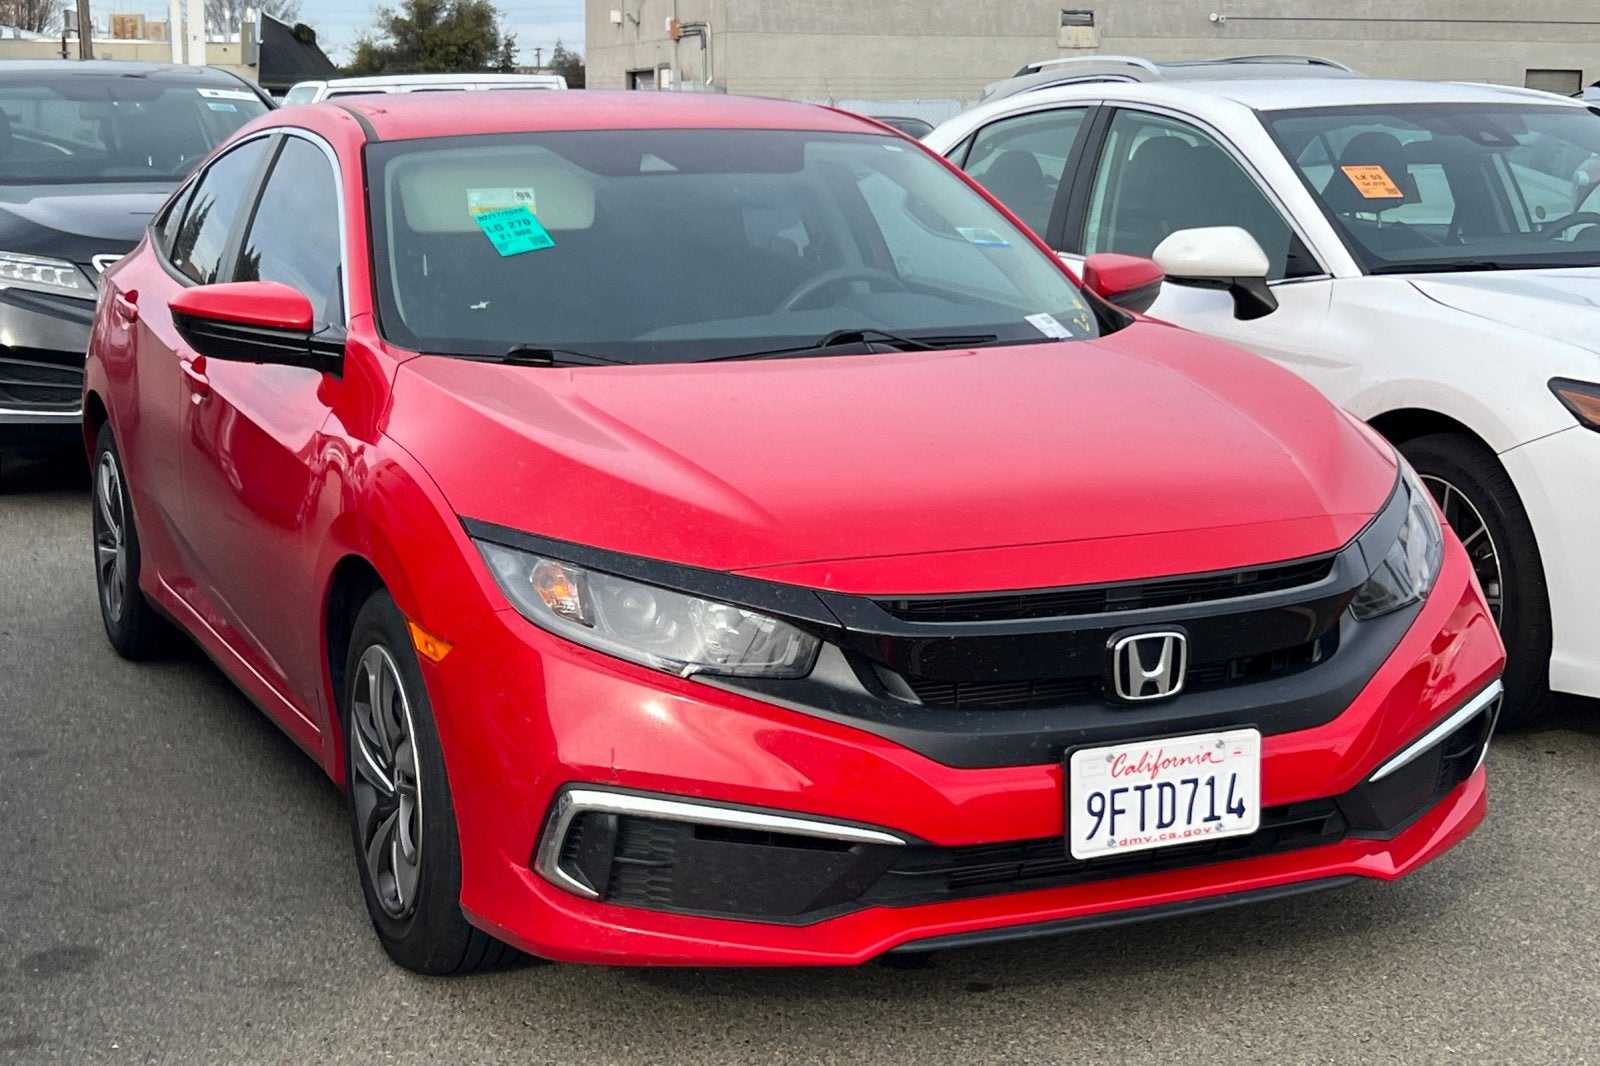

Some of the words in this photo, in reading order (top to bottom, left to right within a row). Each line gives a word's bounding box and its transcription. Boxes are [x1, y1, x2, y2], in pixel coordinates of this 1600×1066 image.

[507, 218, 532, 230] 270
[1110, 747, 1225, 781] California
[1085, 772, 1247, 842] 9FTD714
[1118, 826, 1213, 848] dmv.ca.gov
